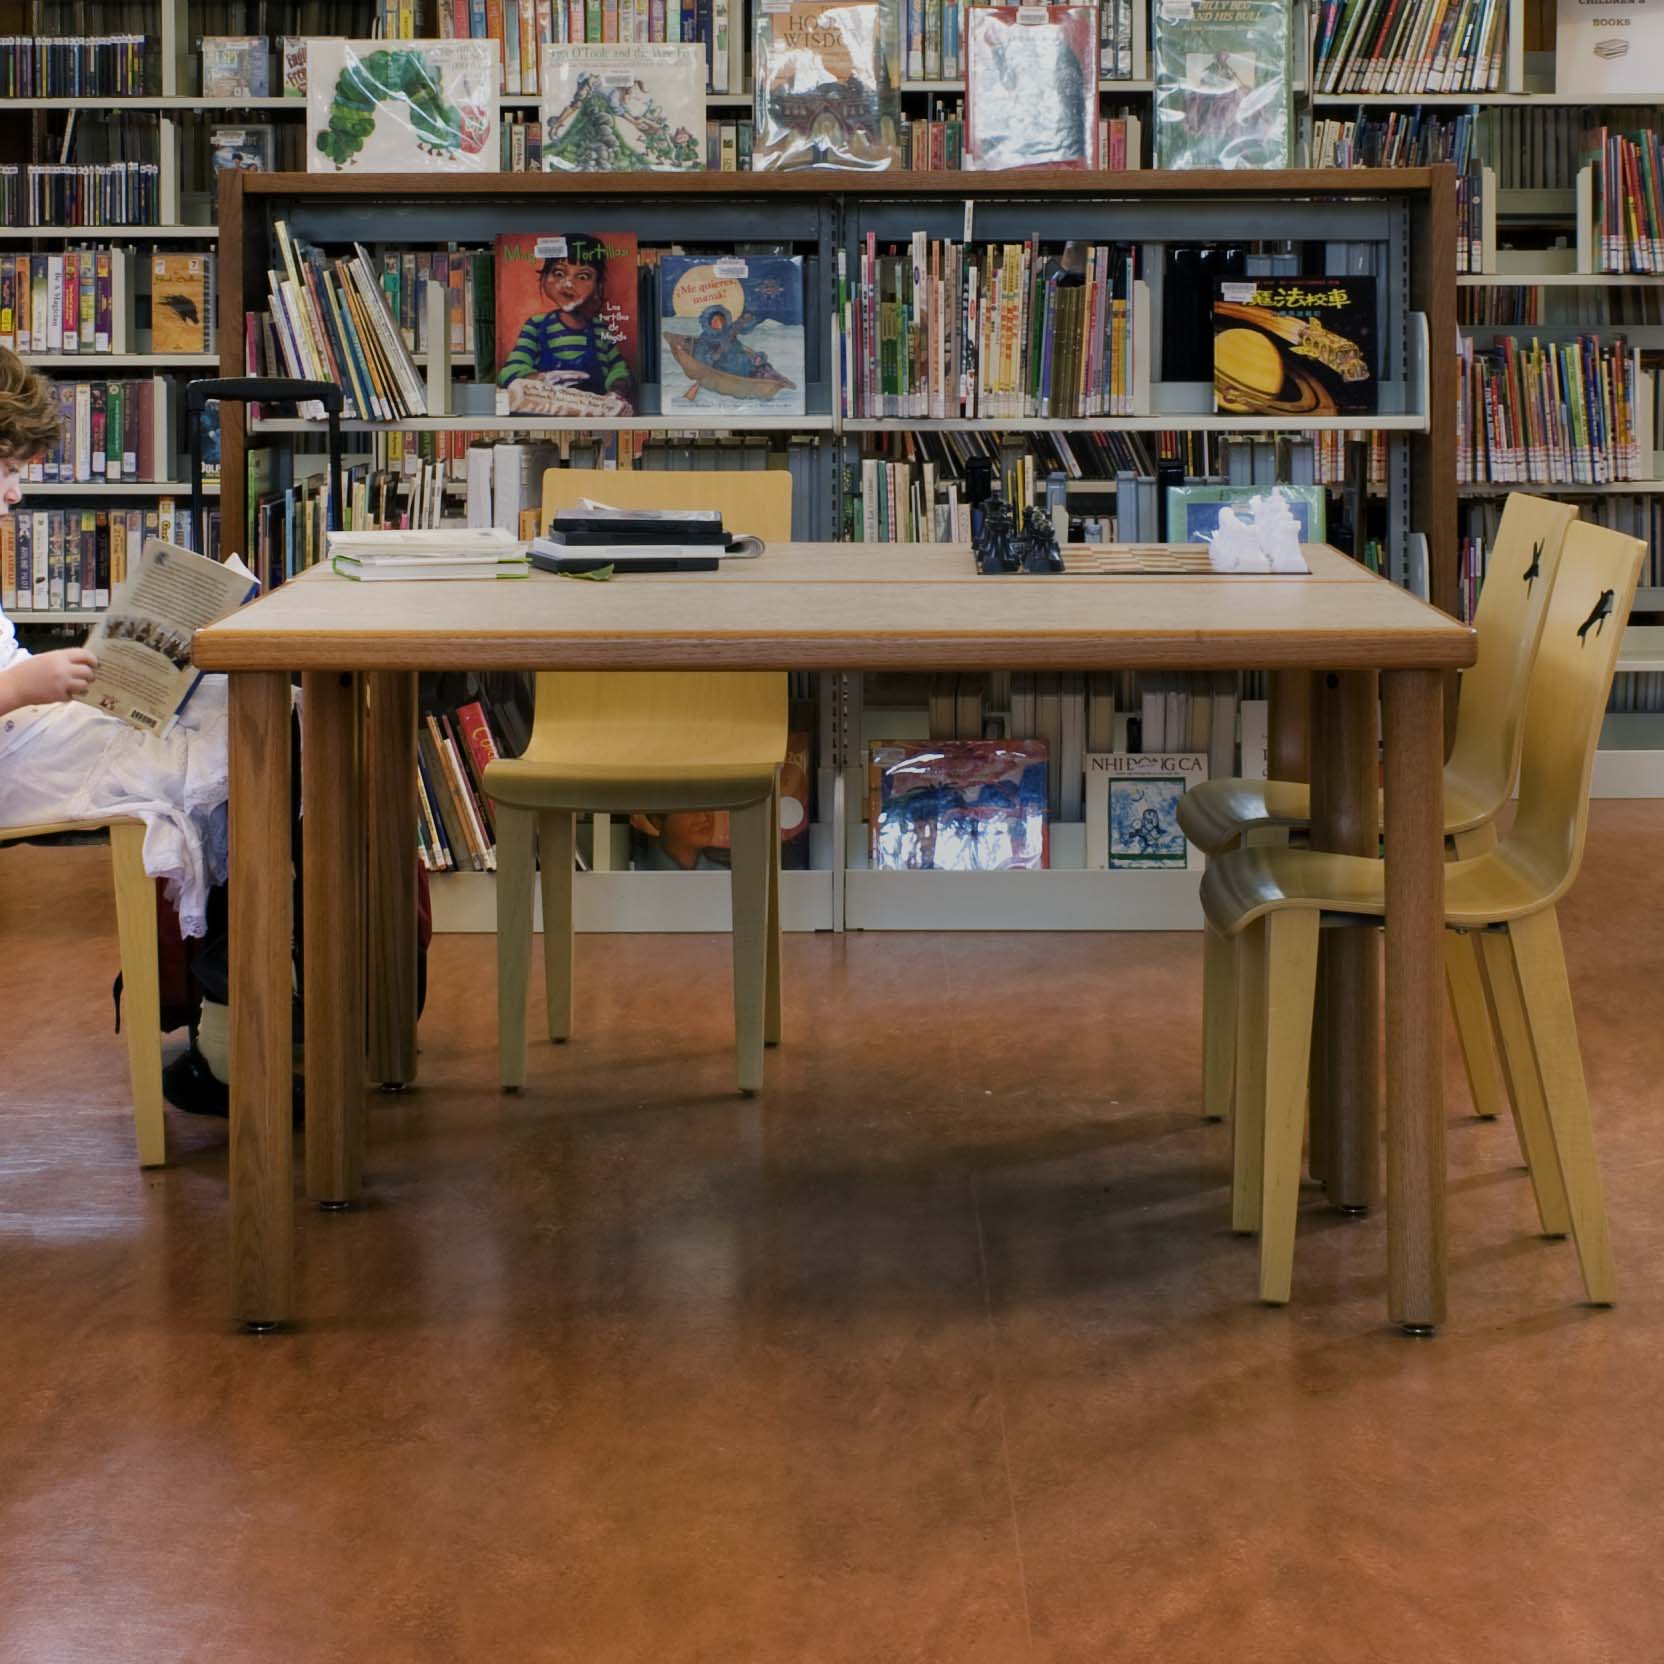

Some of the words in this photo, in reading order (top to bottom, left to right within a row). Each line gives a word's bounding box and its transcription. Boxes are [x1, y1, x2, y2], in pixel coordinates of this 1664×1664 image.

[1193, 11, 1214, 22] ND
[1214, 11, 1234, 22] HIS
[1235, 11, 1262, 22] BULL
[1592, 18, 1631, 27] BOOKS
[608, 320, 619, 332] de
[1091, 756, 1124, 772] NHI
[1178, 756, 1203, 772] CA
